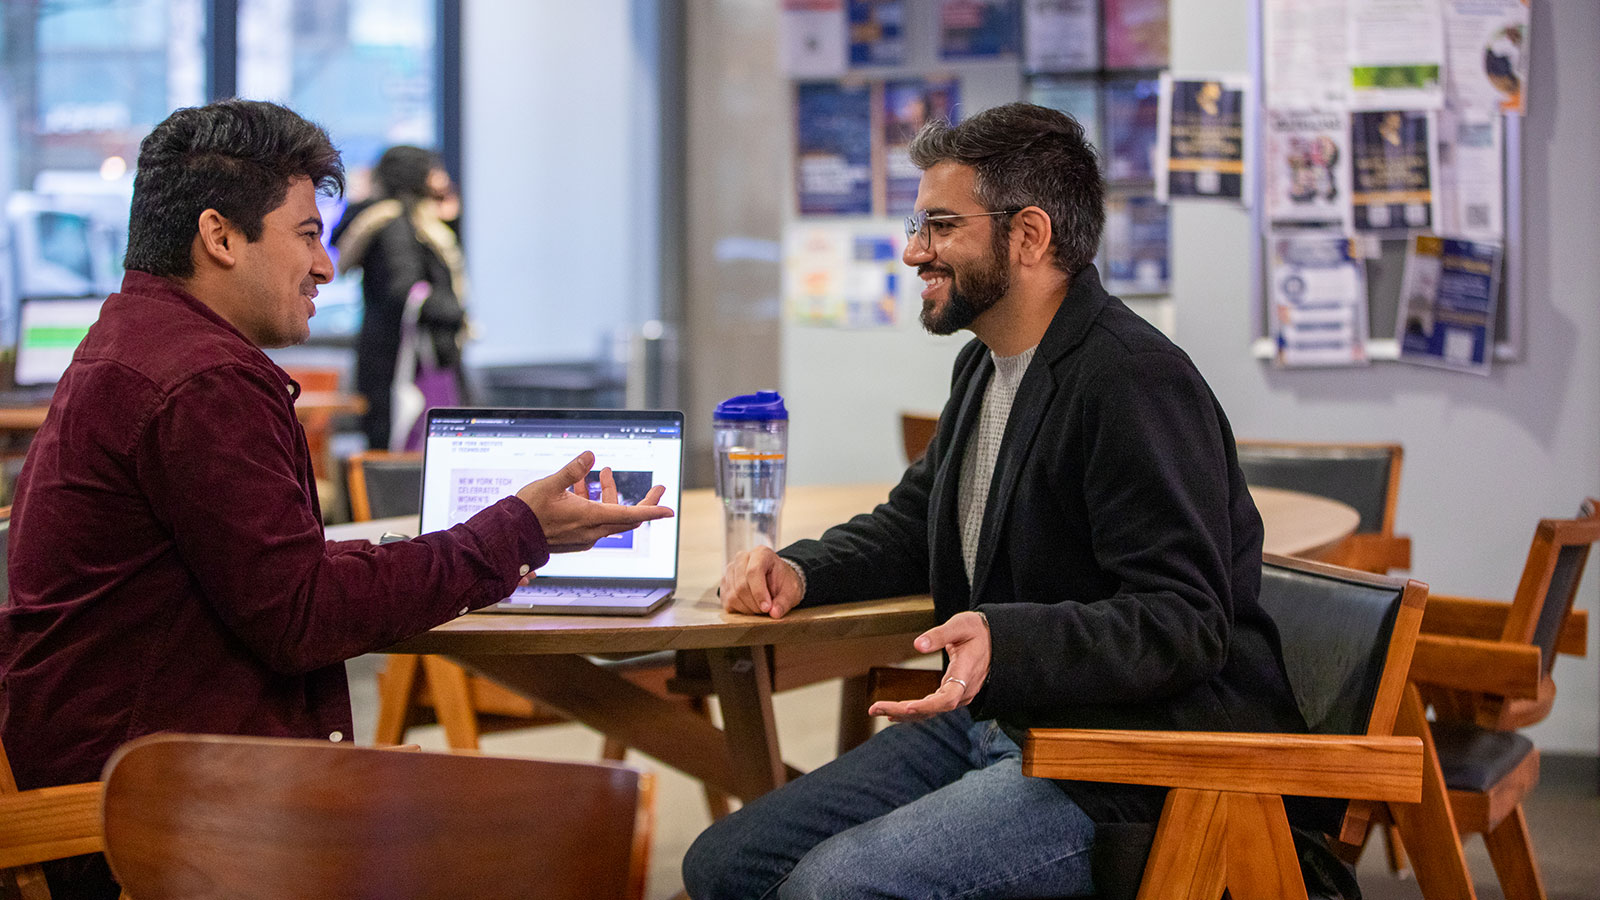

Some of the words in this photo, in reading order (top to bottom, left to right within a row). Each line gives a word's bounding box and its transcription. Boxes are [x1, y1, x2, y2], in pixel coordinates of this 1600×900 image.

[495, 478, 512, 486] TECH
[458, 486, 499, 494] CELEBRATES
[458, 495, 489, 503] WOMEN'S
